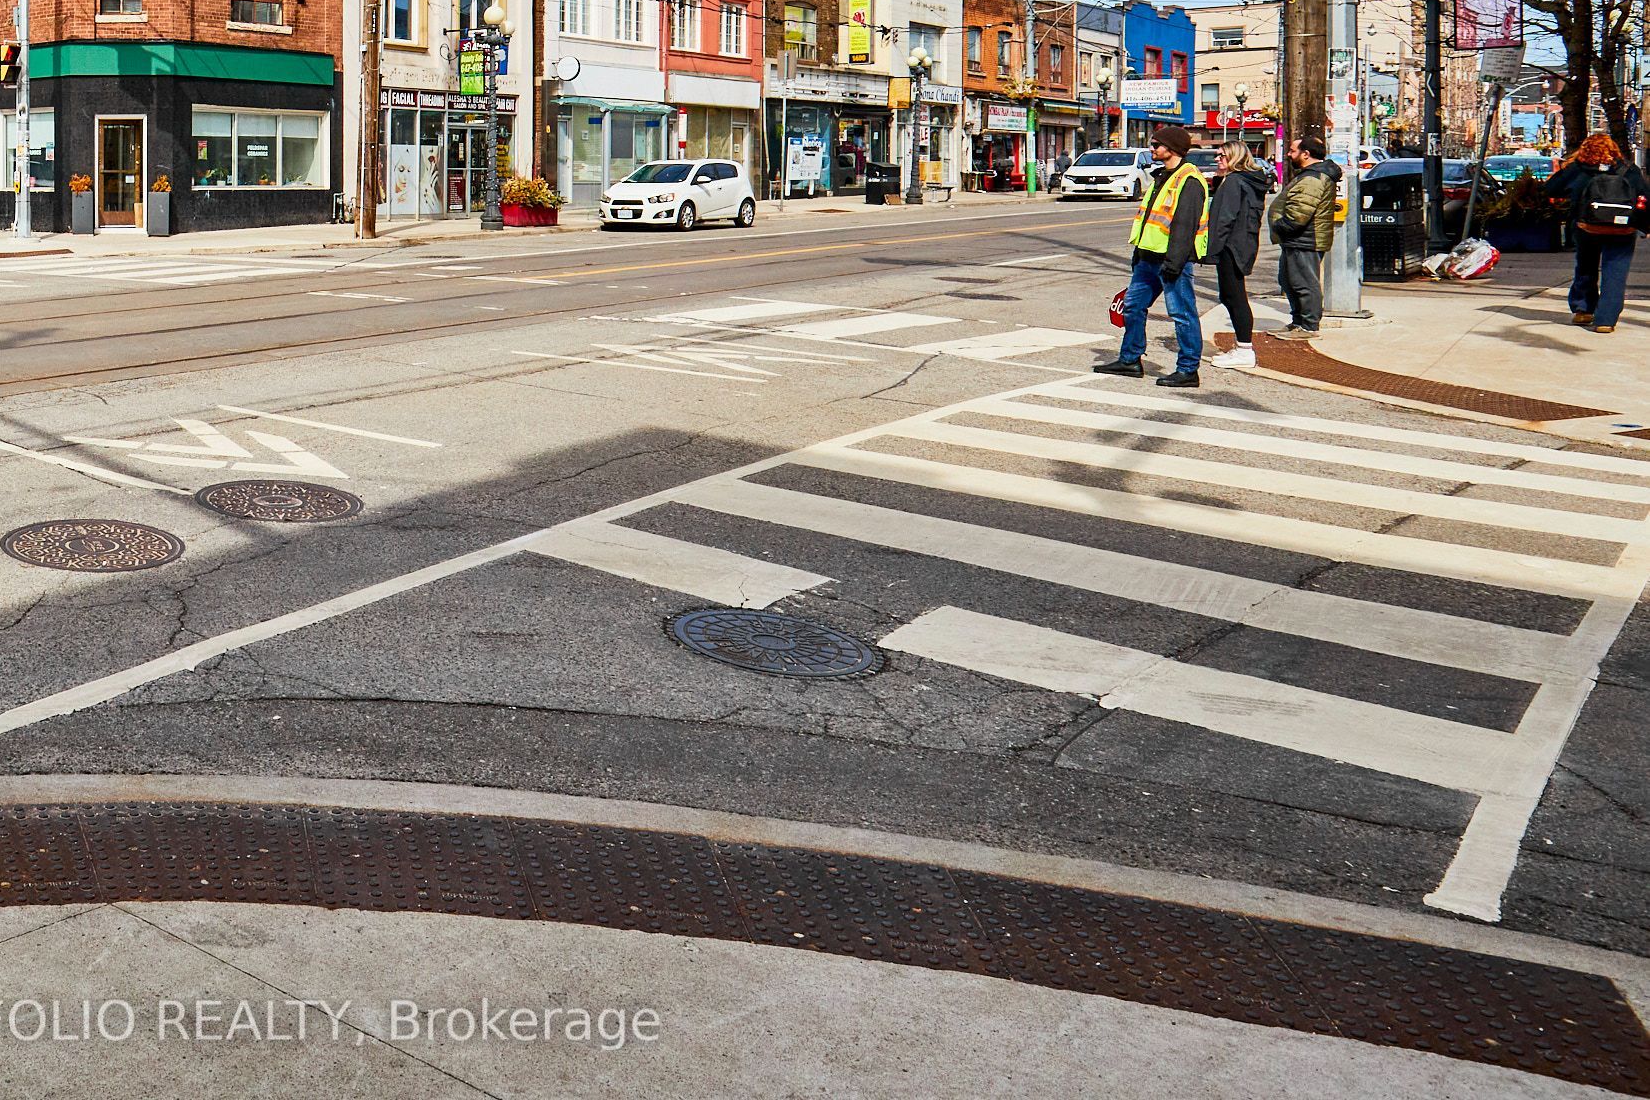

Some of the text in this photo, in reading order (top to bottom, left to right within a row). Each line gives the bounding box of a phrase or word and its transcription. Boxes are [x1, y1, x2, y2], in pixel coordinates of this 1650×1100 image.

[392, 92, 415, 106] FACIAL
[473, 96, 490, 104] BEAUT
[803, 136, 822, 147] Notice
[1360, 214, 1383, 223] Litter
